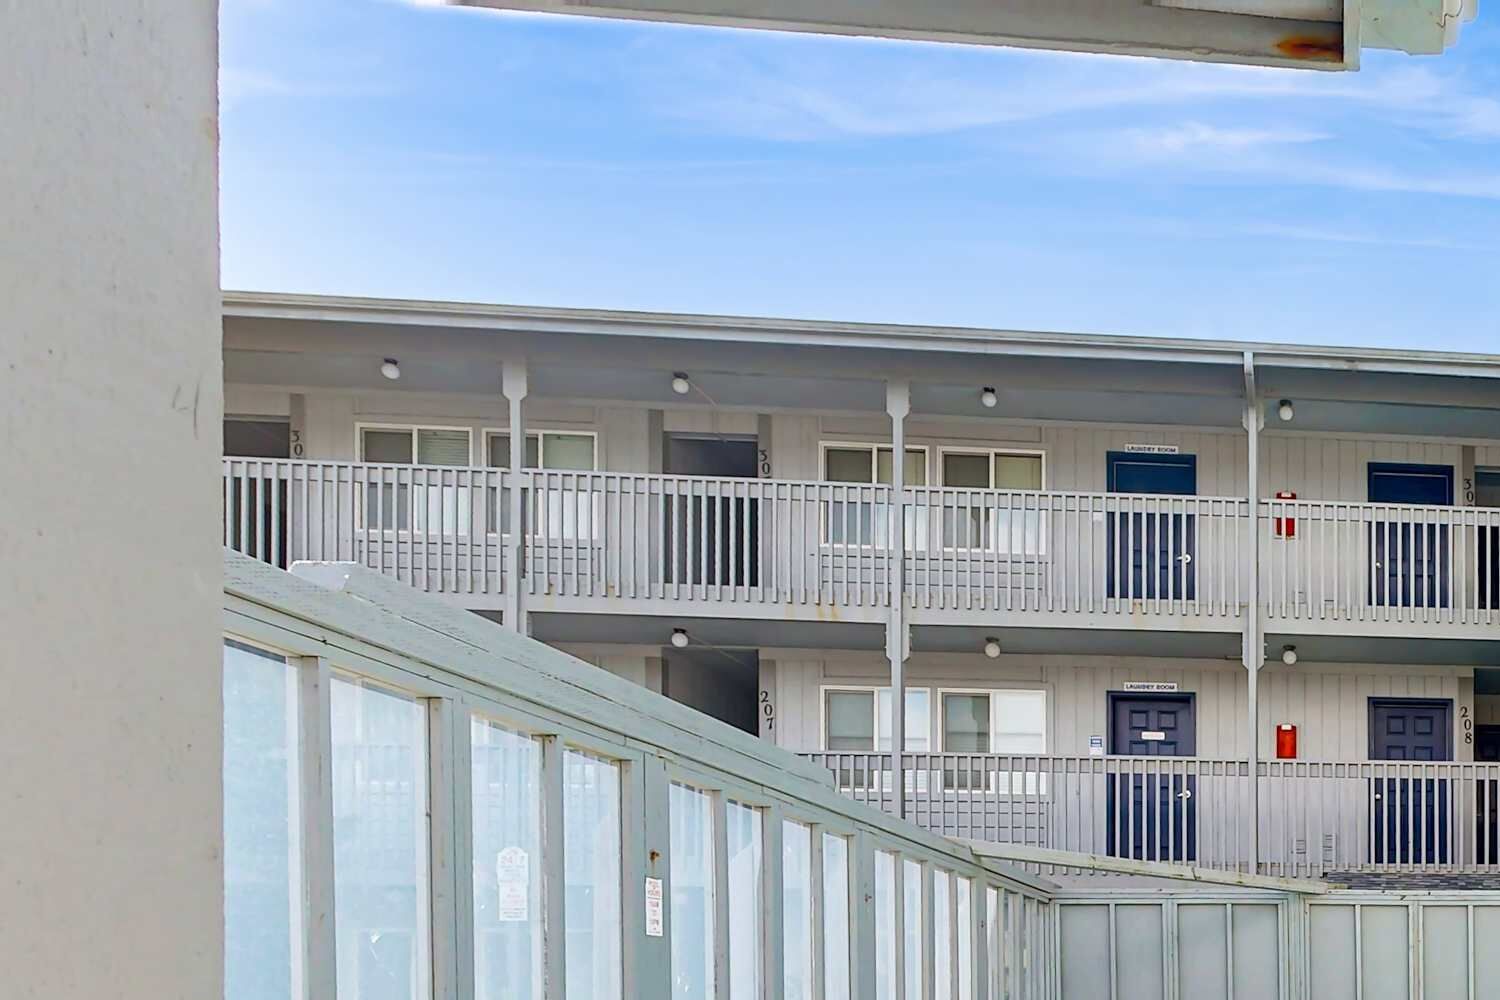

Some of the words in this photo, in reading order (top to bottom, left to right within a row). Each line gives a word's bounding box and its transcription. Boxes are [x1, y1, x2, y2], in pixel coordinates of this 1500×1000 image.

[291, 430, 304, 459] 30
[759, 449, 771, 478] 30
[1463, 478, 1474, 506] 30
[760, 690, 774, 730] 207
[1460, 705, 1473, 744] 208
